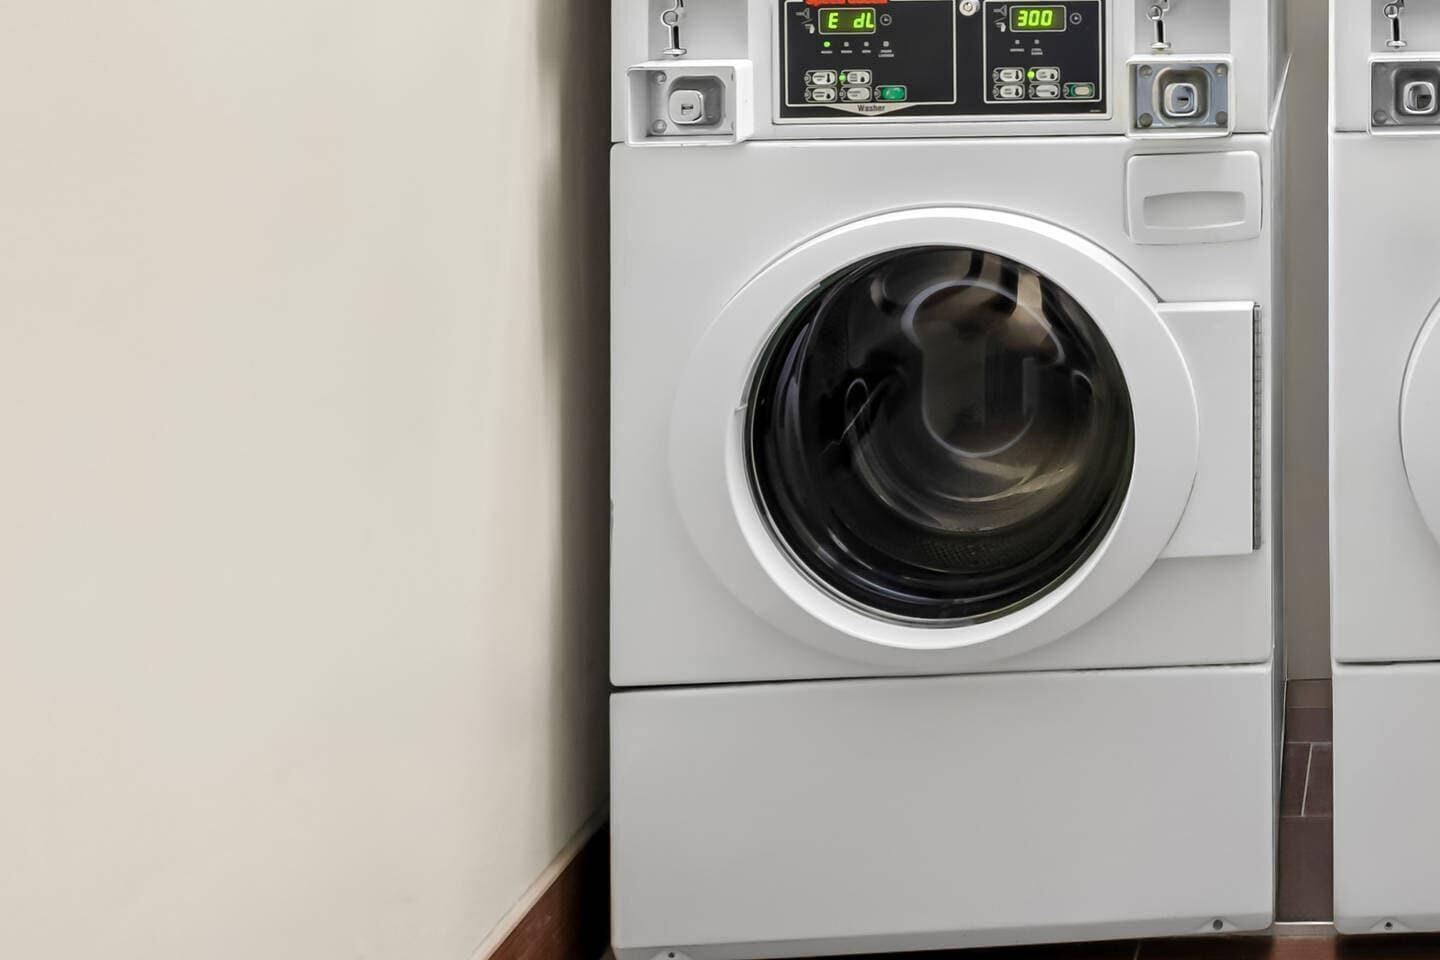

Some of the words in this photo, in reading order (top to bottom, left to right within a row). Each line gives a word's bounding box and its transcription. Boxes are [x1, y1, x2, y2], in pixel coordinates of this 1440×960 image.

[828, 12, 839, 29] E
[1017, 9, 1053, 27] 300
[857, 104, 886, 113] Washer
